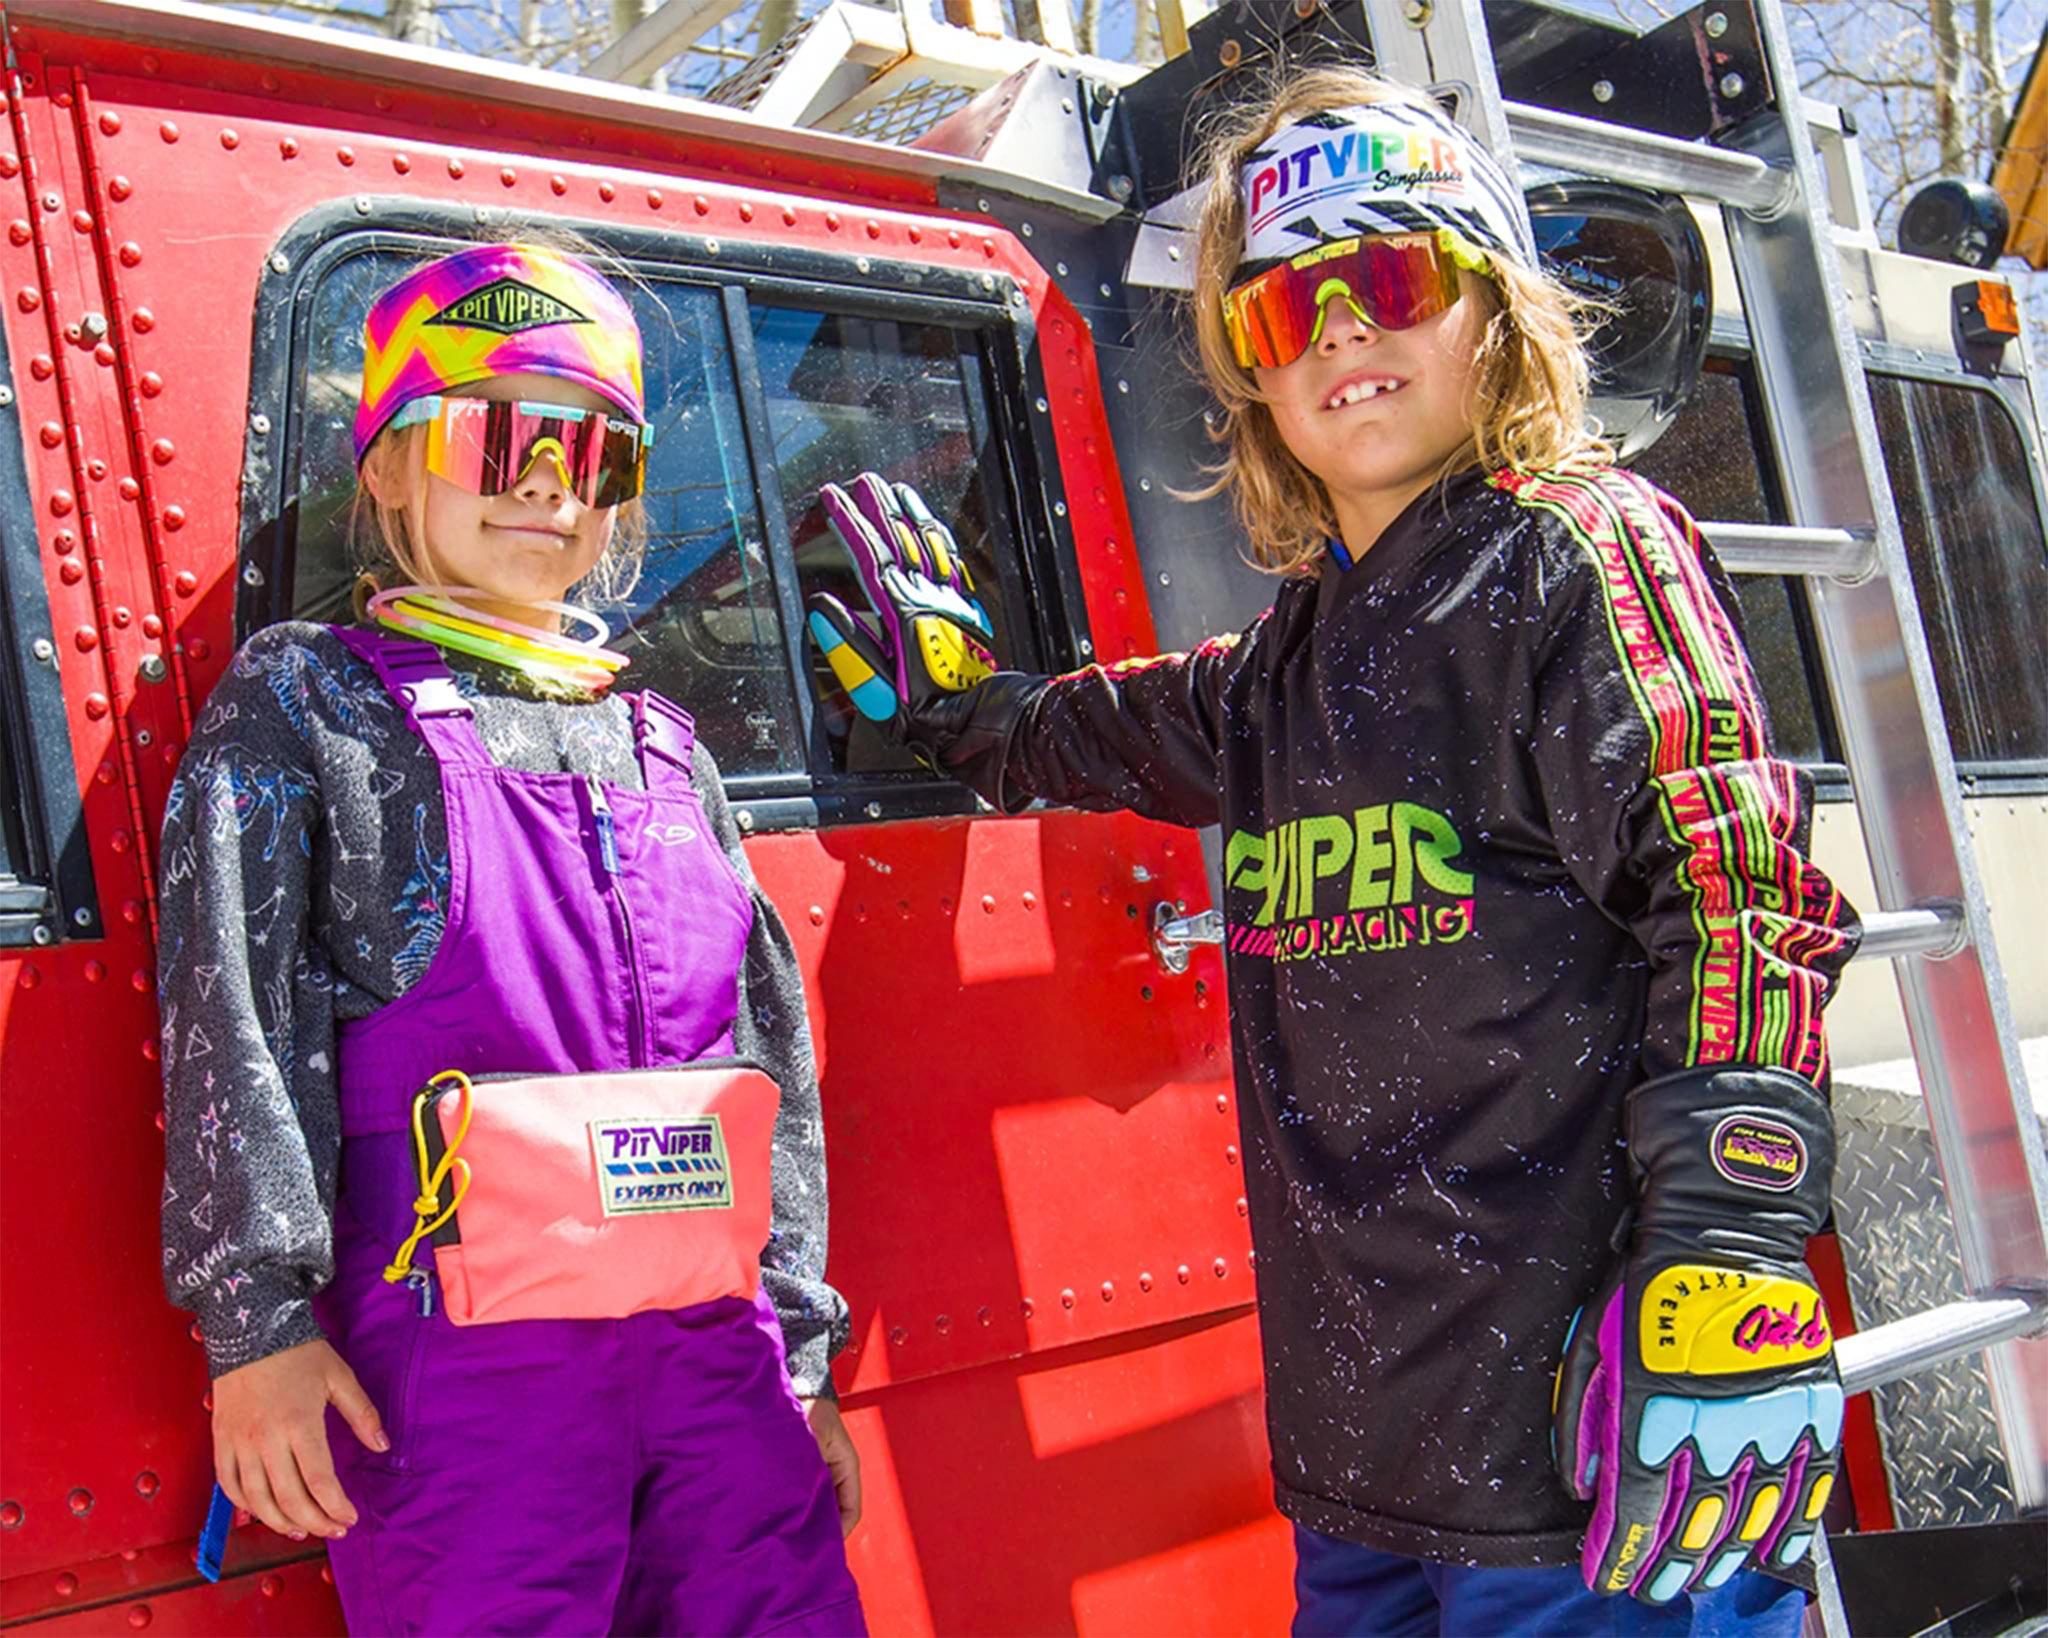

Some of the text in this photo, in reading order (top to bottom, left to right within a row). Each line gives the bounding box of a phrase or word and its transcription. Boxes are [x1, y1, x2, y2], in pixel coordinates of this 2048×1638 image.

[464, 288, 557, 323] PIT VIPER
[1318, 899, 1476, 952] RACING
[615, 1180, 726, 1205] EXPERTS ONLY
[1659, 1272, 1748, 1347] EXTREME
[1732, 1298, 1830, 1353] PRO
